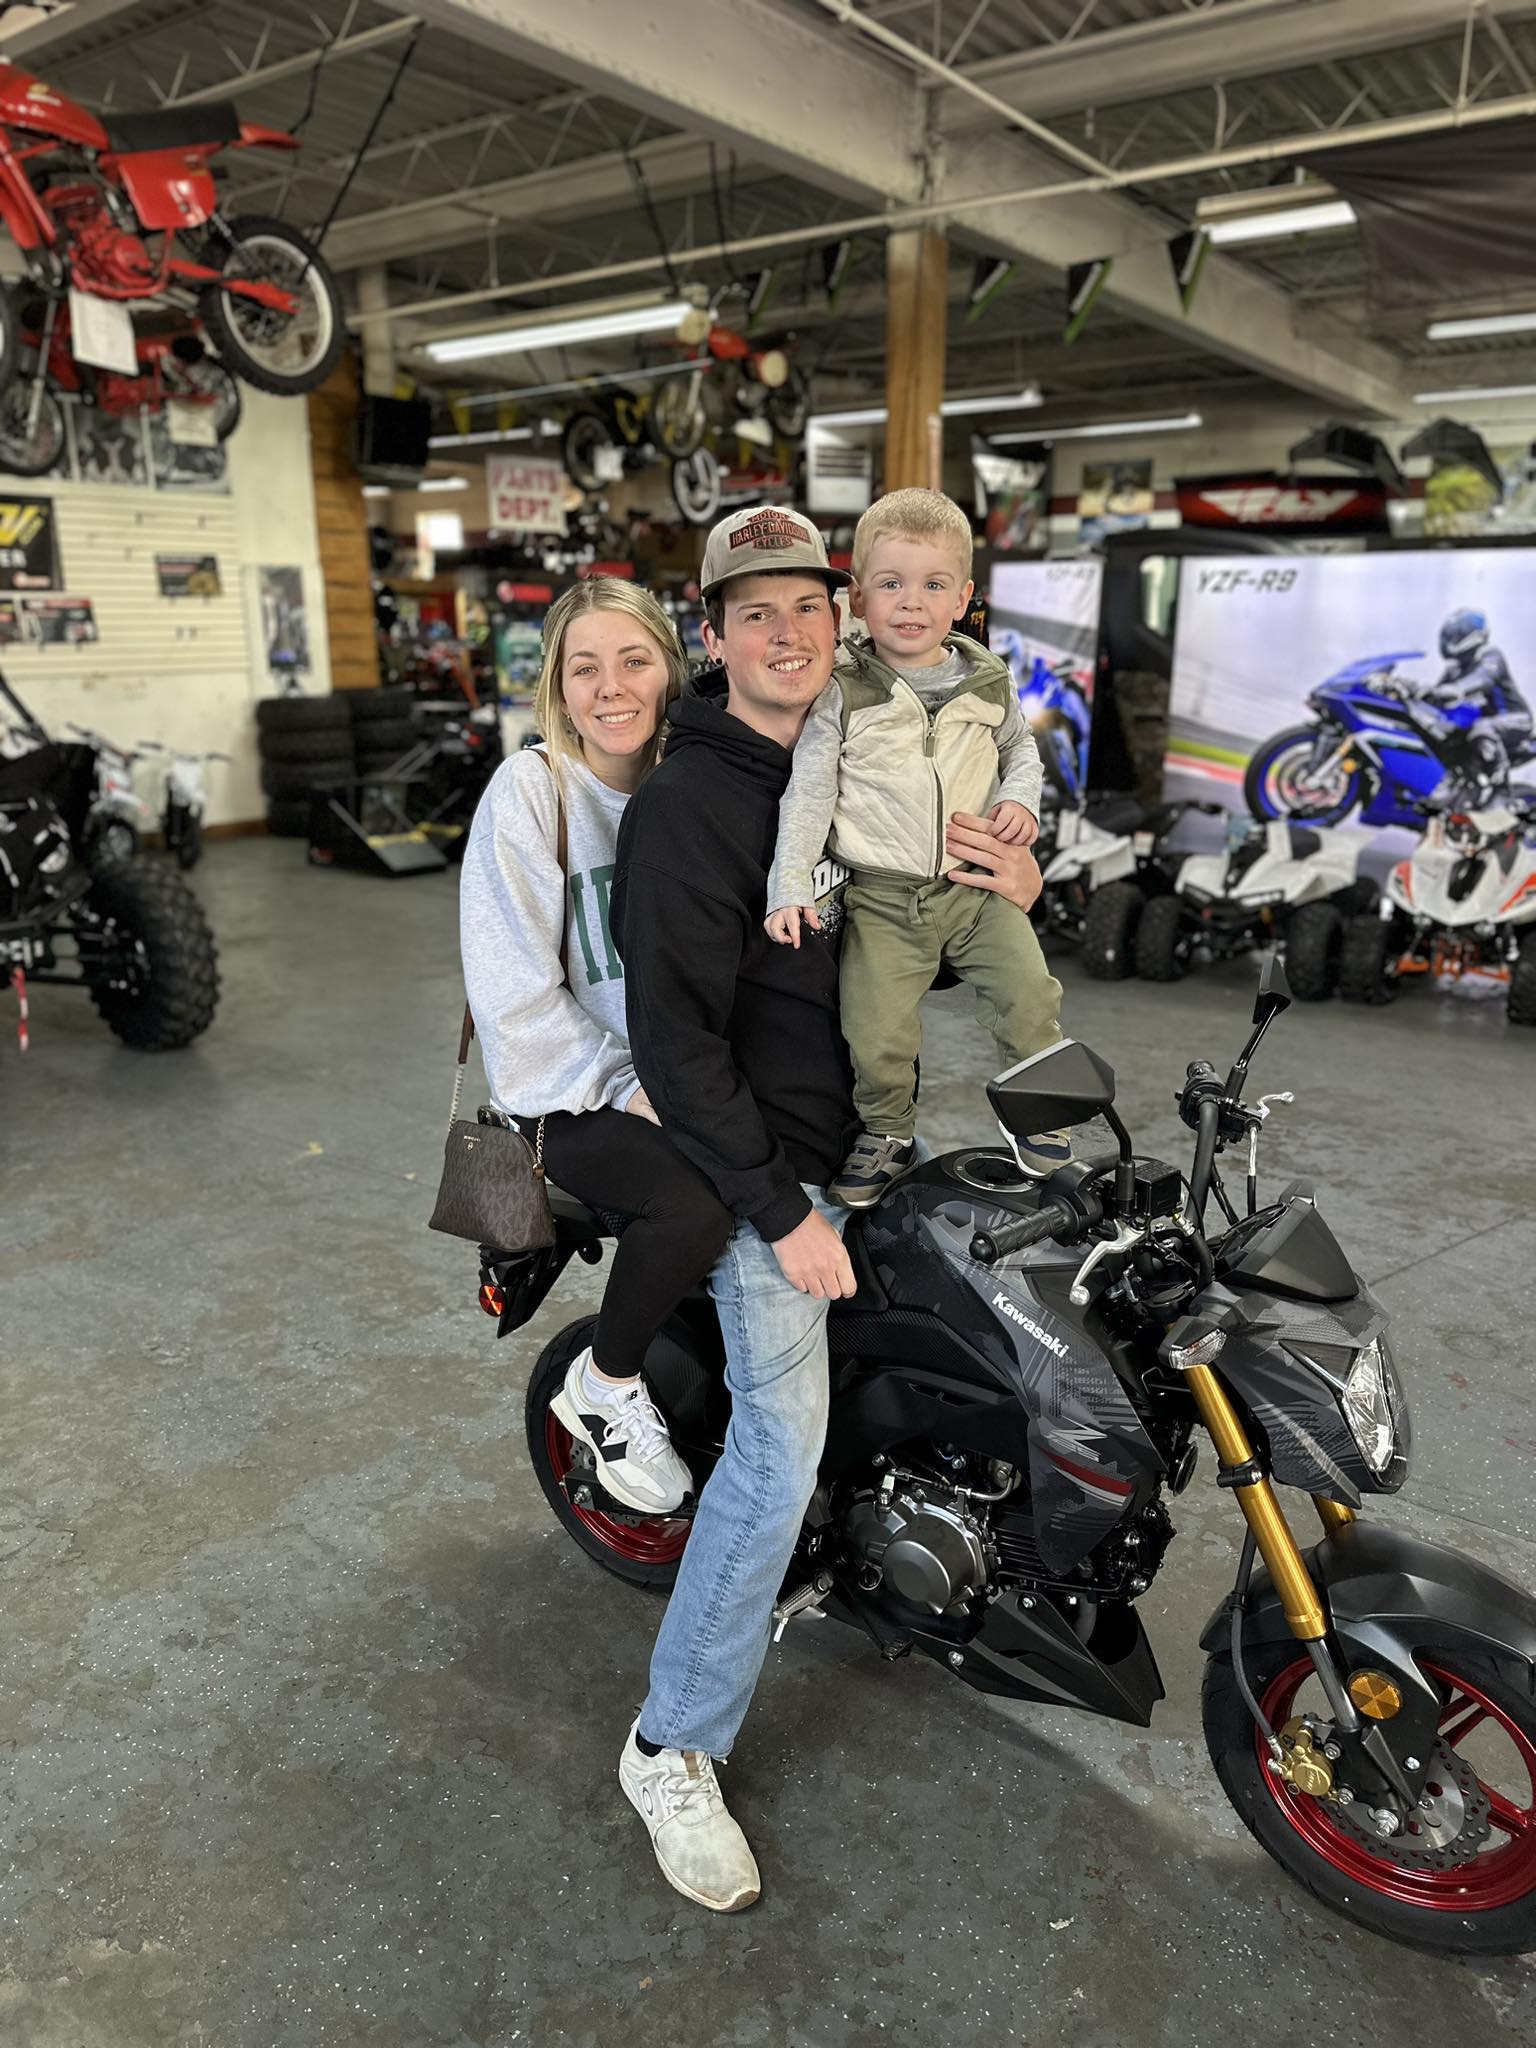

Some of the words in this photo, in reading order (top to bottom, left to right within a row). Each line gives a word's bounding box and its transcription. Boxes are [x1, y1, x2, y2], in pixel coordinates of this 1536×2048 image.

[492, 464, 560, 494] PARTS
[751, 510, 789, 523] MOTOR
[731, 519, 811, 546] HARLEY-DAVIDSON
[755, 535, 792, 548] CYCLES
[1199, 568, 1298, 594] YZF-R9
[992, 1291, 1070, 1359] Kawasaki
